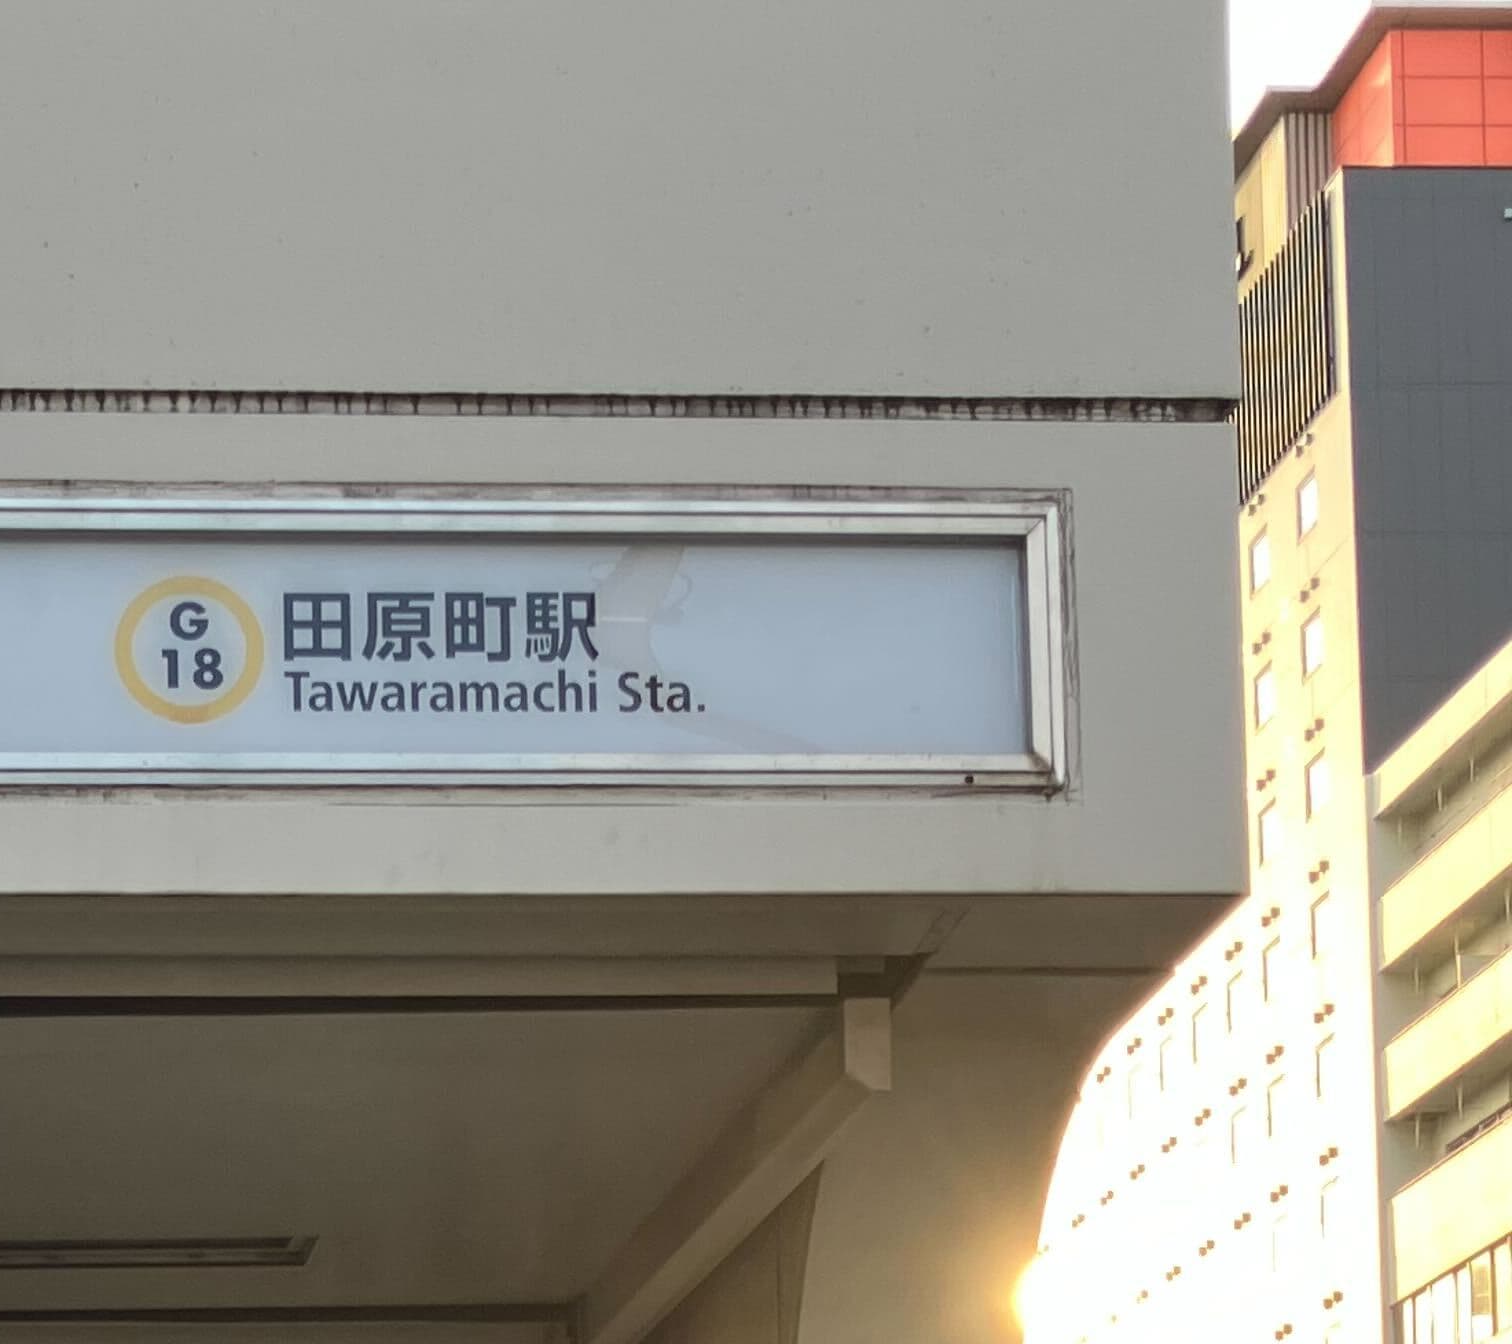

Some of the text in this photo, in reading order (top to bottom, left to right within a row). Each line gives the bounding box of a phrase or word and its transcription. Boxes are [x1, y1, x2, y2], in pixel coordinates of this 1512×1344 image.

[169, 602, 209, 641] G
[283, 592, 599, 662] 田原町駅
[161, 648, 224, 690] 18
[284, 670, 707, 713] Tawaramachi Sta.
